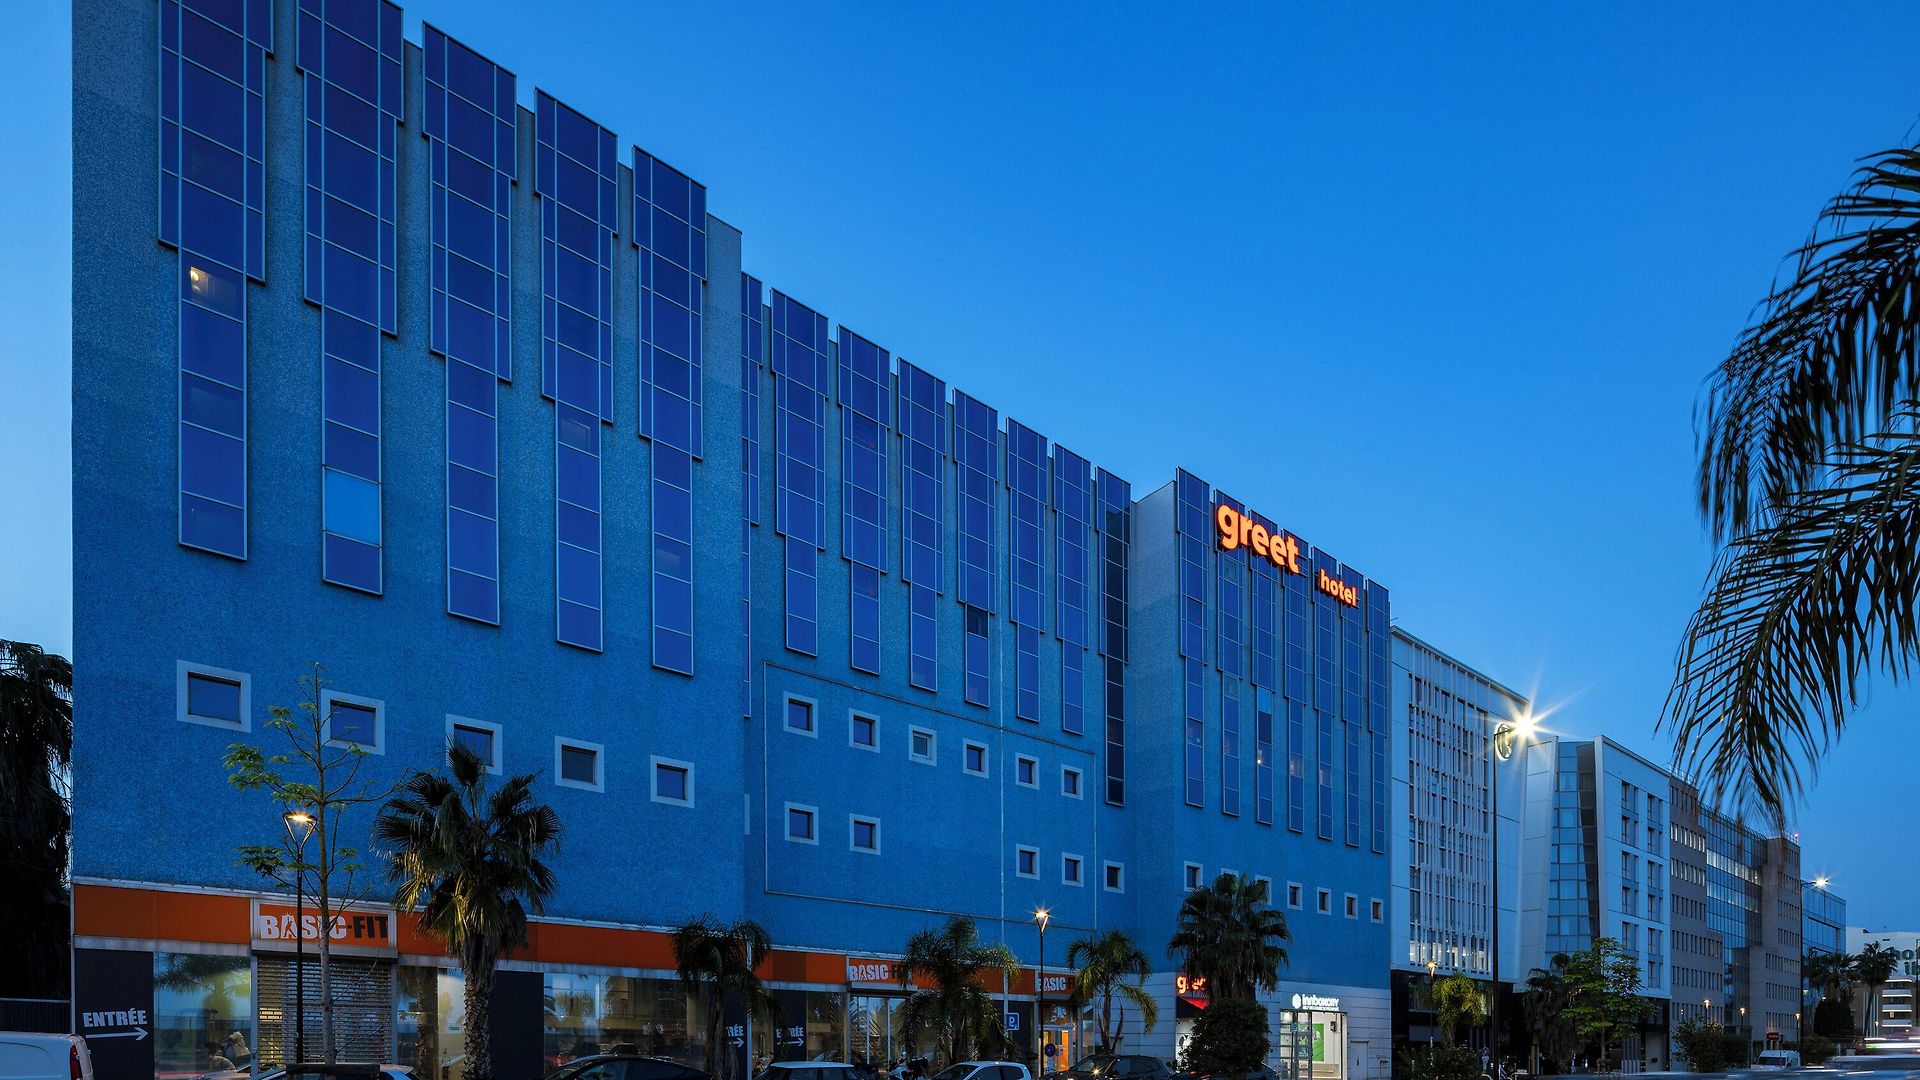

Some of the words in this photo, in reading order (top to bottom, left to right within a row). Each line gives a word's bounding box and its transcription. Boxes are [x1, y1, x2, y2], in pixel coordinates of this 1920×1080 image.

[1217, 504, 1300, 574] greet
[1319, 568, 1357, 606] hotel
[83, 1008, 147, 1027] ENTRÉE
[776, 1026, 804, 1038] ERÉE
